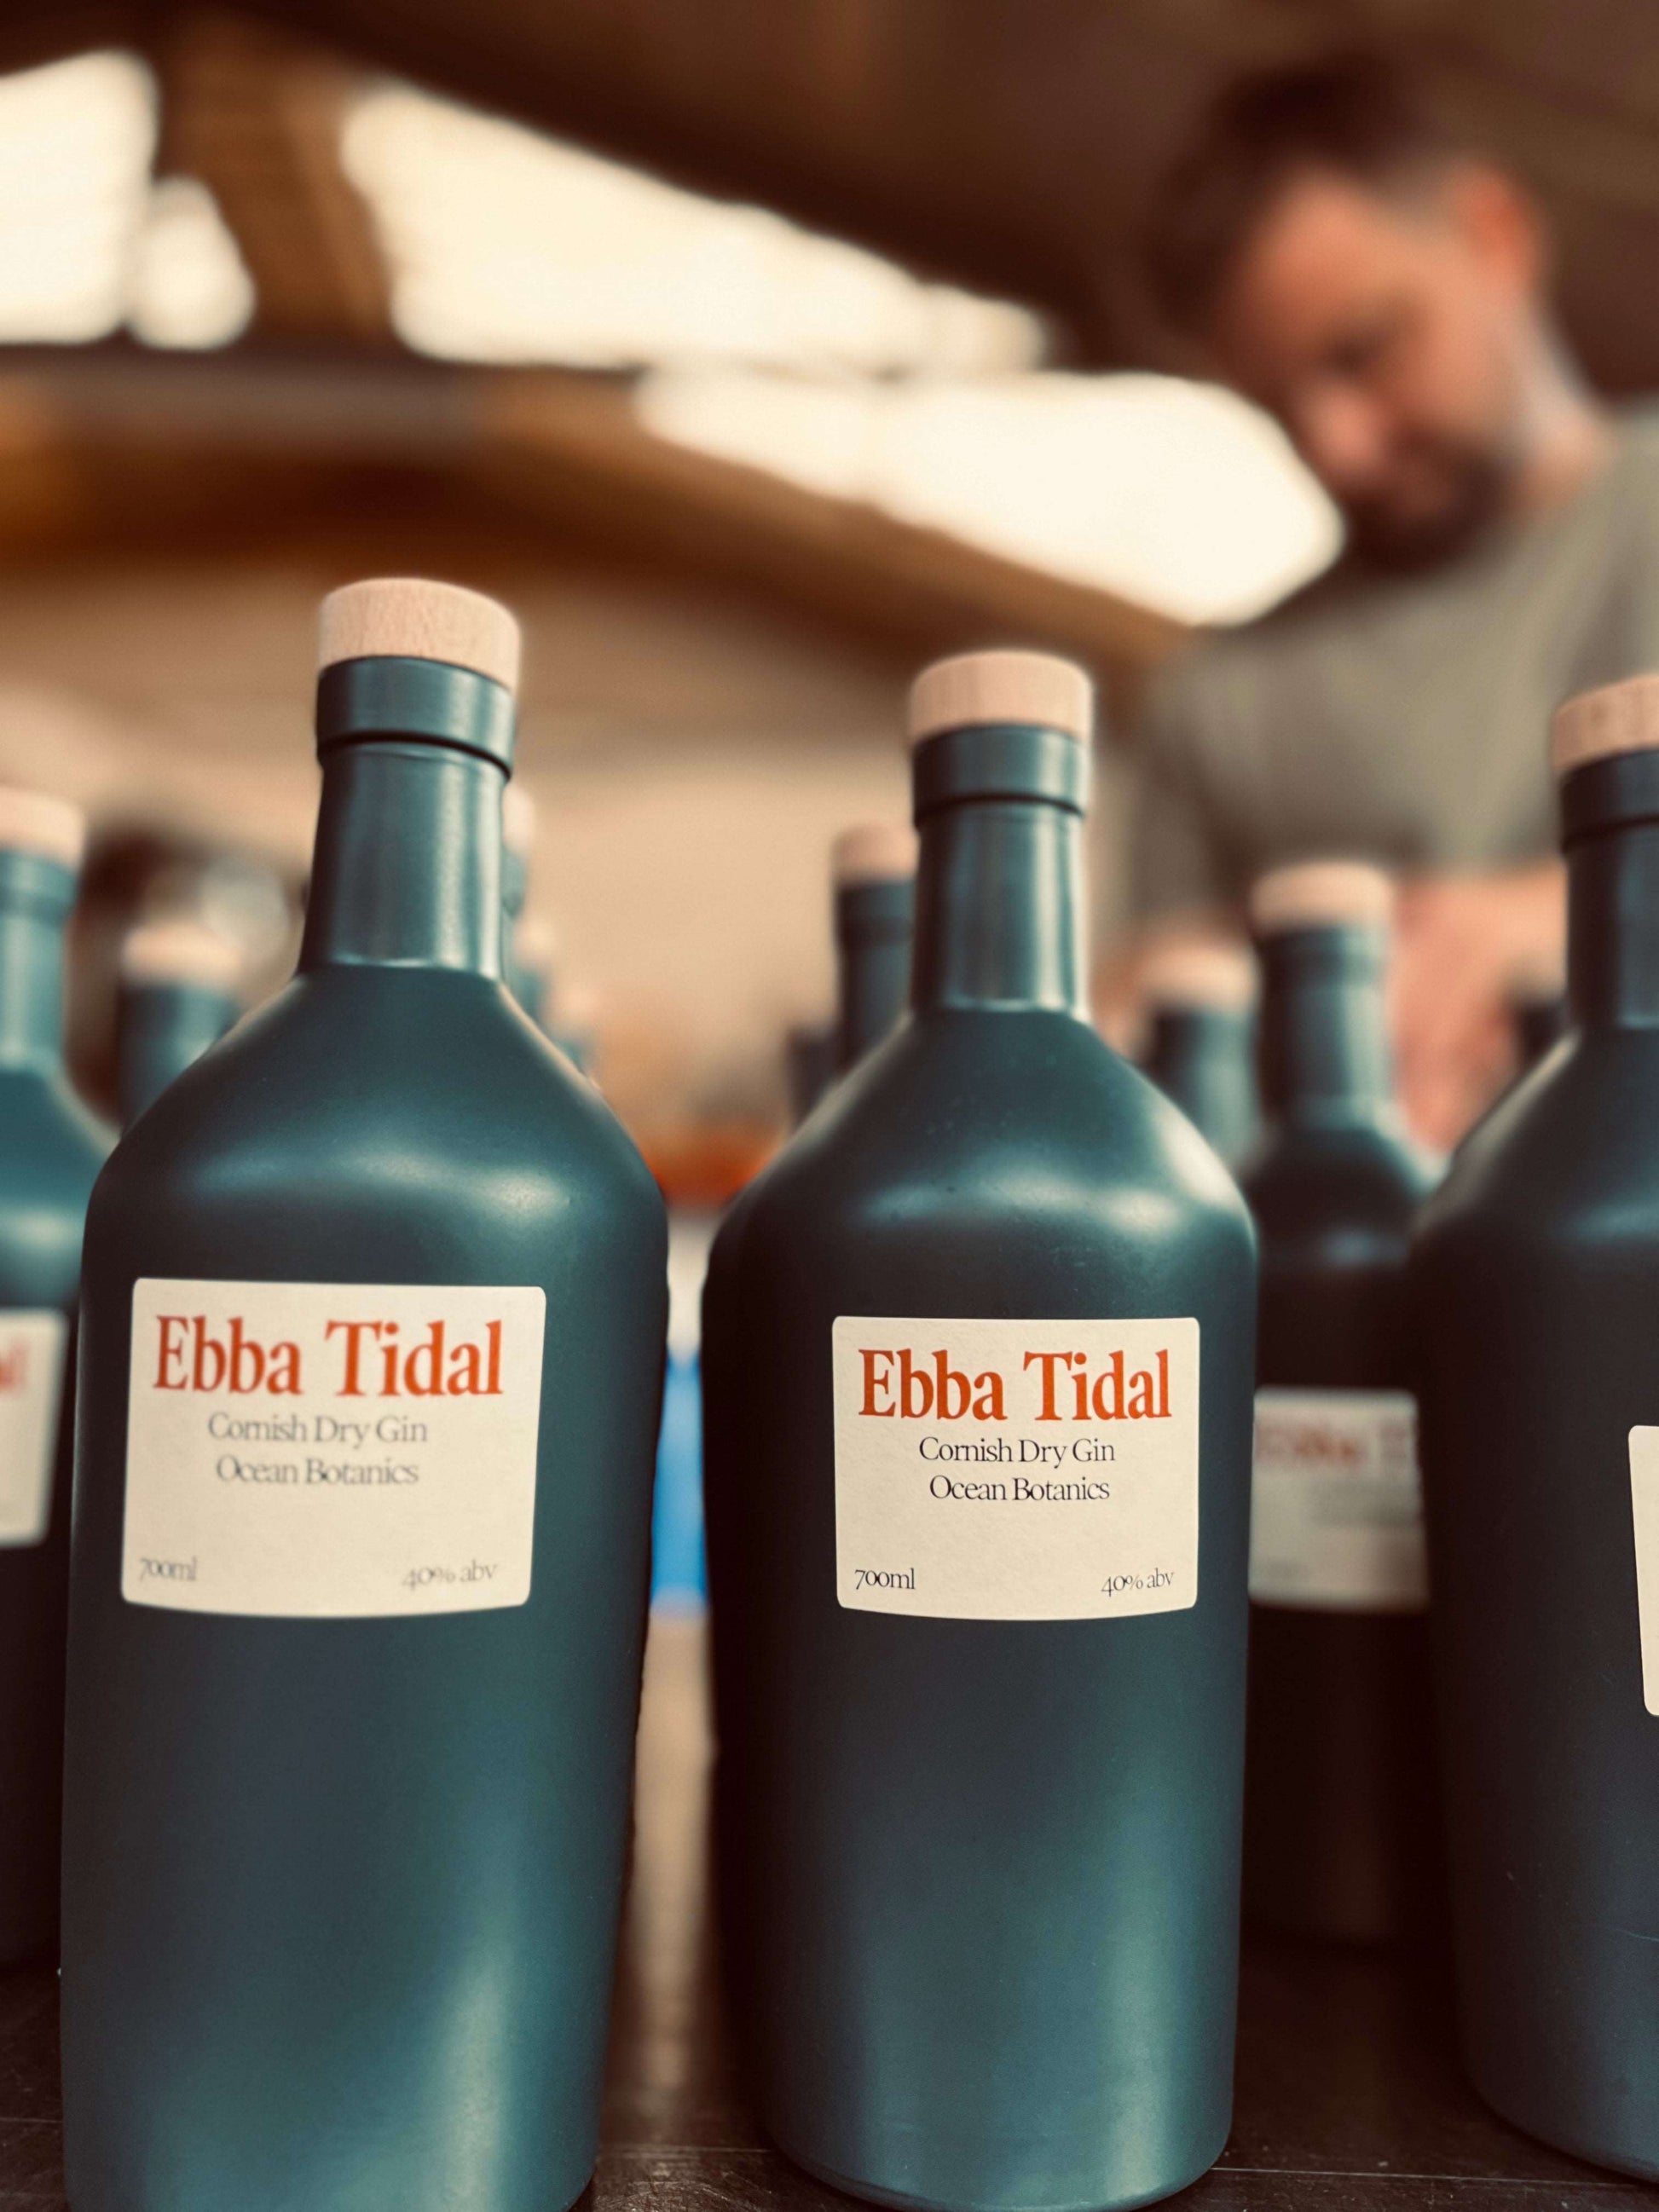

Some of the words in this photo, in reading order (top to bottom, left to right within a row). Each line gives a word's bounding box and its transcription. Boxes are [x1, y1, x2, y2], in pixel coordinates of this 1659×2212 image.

[153, 1314, 303, 1396] Ebba
[324, 1318, 505, 1398] Tidal
[858, 1347, 1009, 1421] Ebba
[1023, 1349, 1173, 1421] Tidal
[207, 1412, 307, 1443] Cornish
[314, 1415, 370, 1449] Dry
[375, 1416, 428, 1443] Gin
[919, 1436, 1013, 1463] Cornish
[1018, 1439, 1068, 1469] Dry
[1072, 1438, 1116, 1463] Gin
[216, 1453, 298, 1485] Ocean
[305, 1457, 419, 1487] Botanics
[929, 1475, 1007, 1502] Ocean
[1012, 1476, 1111, 1501] Botanics
[139, 1556, 198, 1583] 700ml
[402, 1565, 455, 1592] 40%
[460, 1559, 499, 1585] abv
[854, 1567, 916, 1591] 700ml
[1101, 1574, 1144, 1597] 40%
[1147, 1567, 1176, 1591] abv
